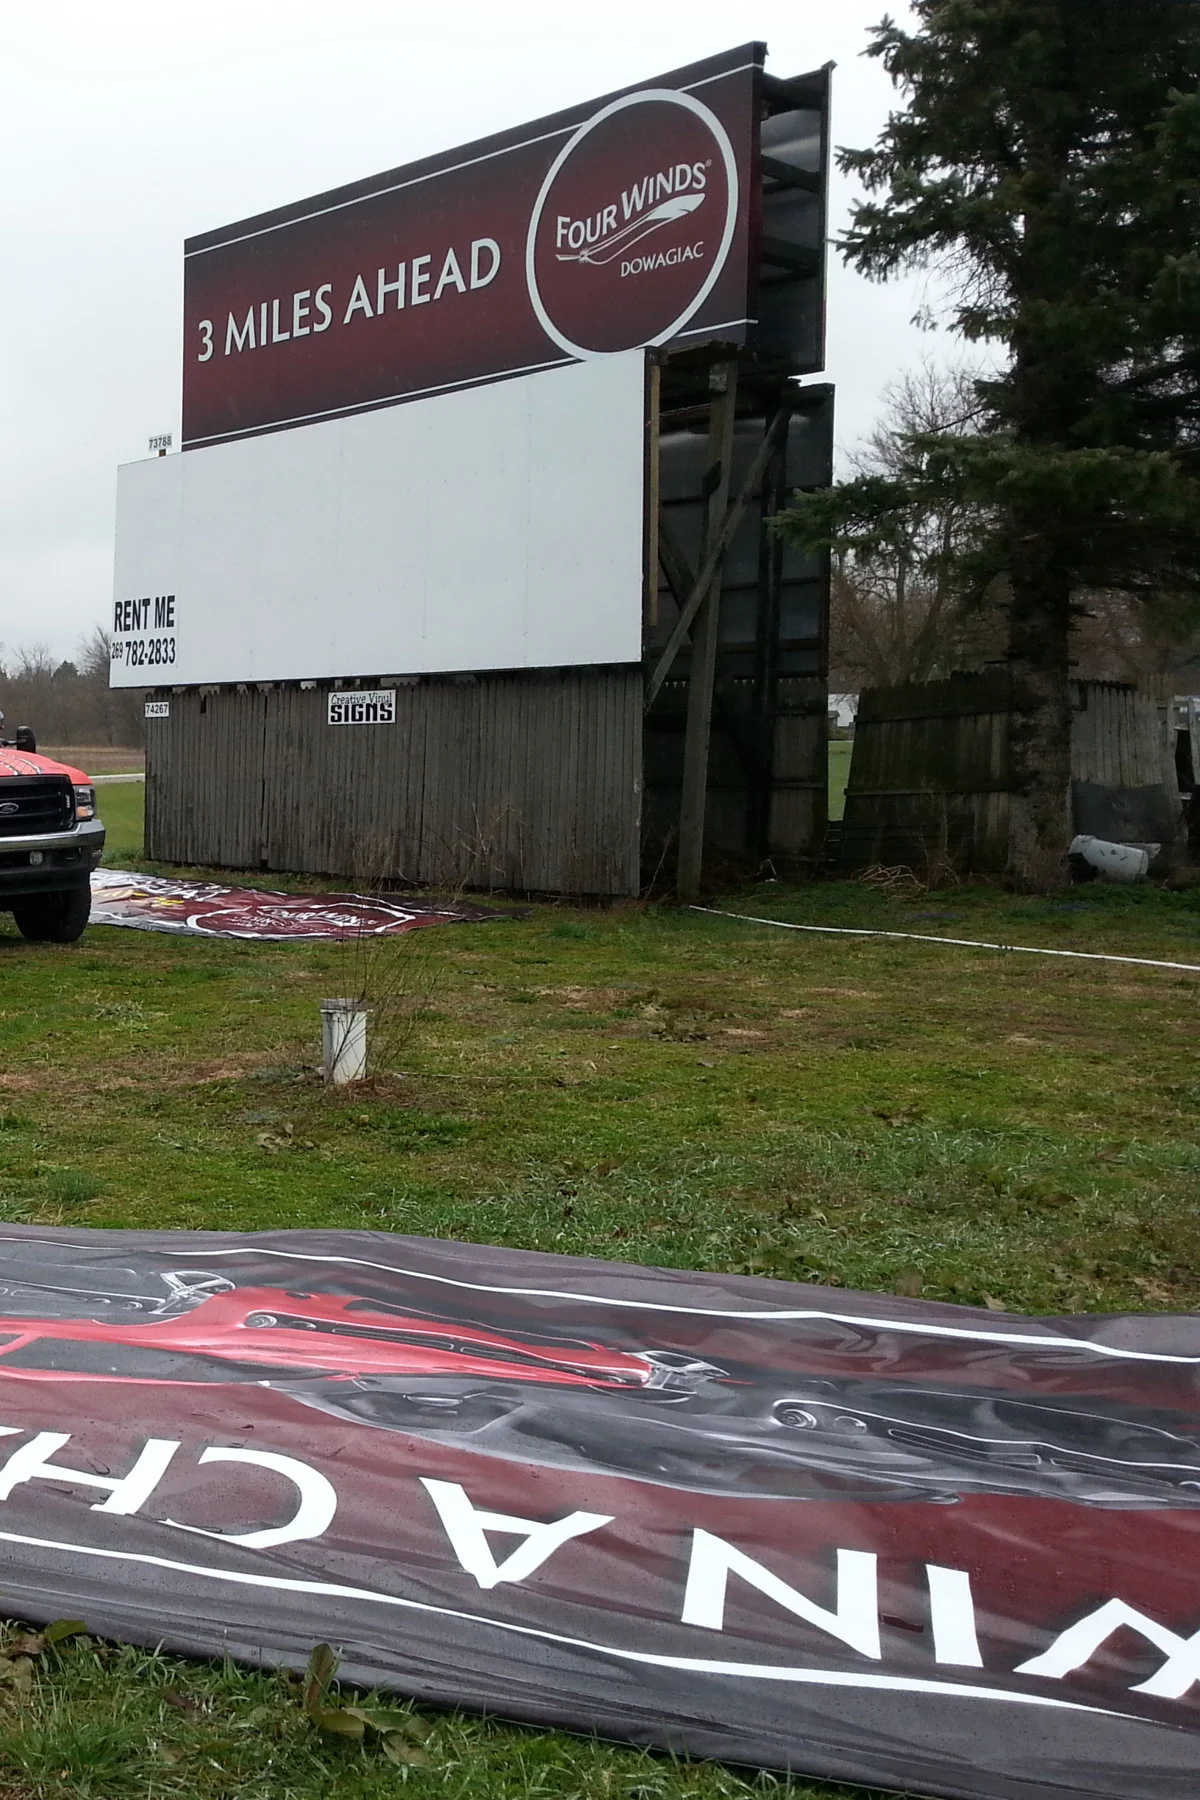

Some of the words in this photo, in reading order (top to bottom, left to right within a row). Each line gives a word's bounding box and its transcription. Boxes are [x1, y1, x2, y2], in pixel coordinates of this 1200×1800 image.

[556, 204, 618, 249] FOUR
[620, 241, 705, 278] DOWAGIAC
[198, 319, 214, 362] 3
[224, 283, 333, 356] MILES
[343, 237, 502, 324] AHEAD
[114, 598, 151, 633] RENT
[154, 595, 176, 630] ME
[111, 641, 123, 660] 269
[125, 637, 176, 667] 782-2833
[146, 703, 168, 715] 74267
[330, 703, 393, 723] SIGNS
[331, 693, 367, 705] Creative
[369, 691, 392, 706] Vinyl
[418, 1476, 616, 1589] A
